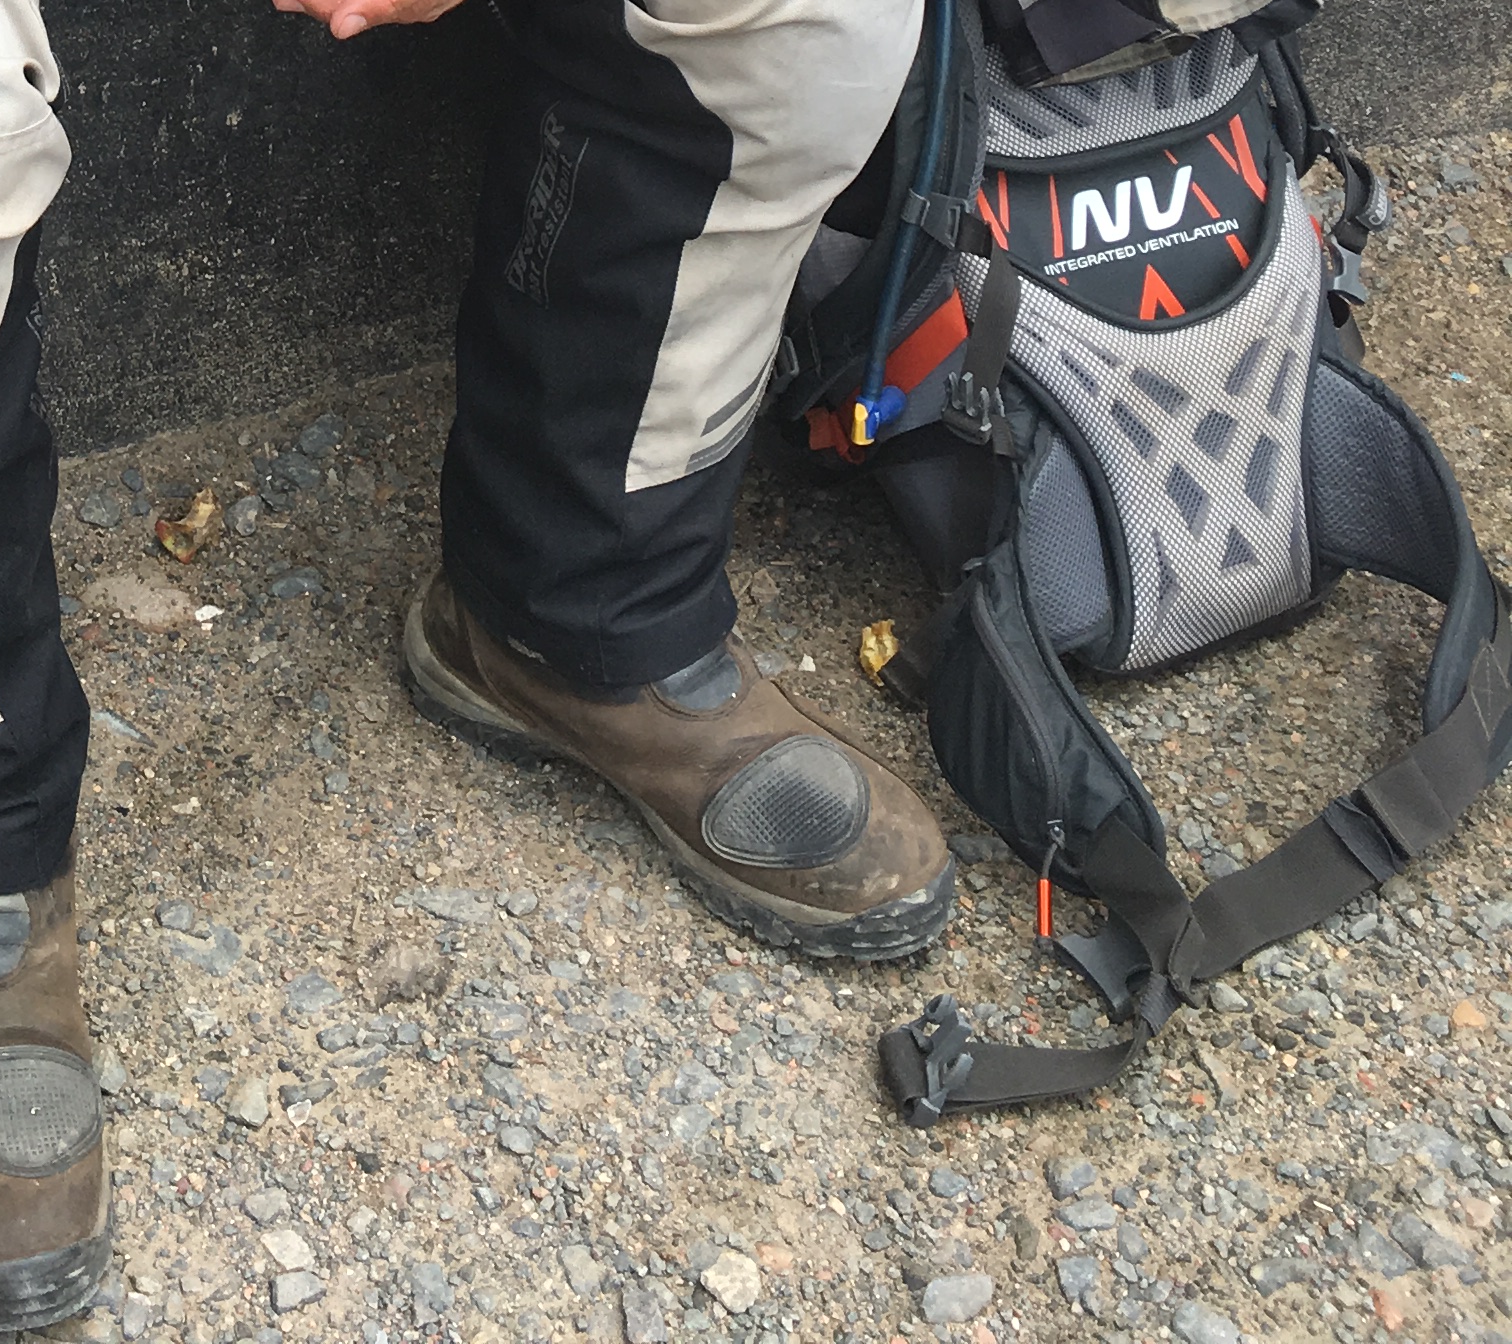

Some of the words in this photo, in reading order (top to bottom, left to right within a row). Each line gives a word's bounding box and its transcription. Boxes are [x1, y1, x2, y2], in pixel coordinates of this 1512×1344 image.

[1071, 165, 1193, 251] NV
[1044, 245, 1136, 276] INTEGRATED
[1137, 218, 1239, 254] VENTILATION
